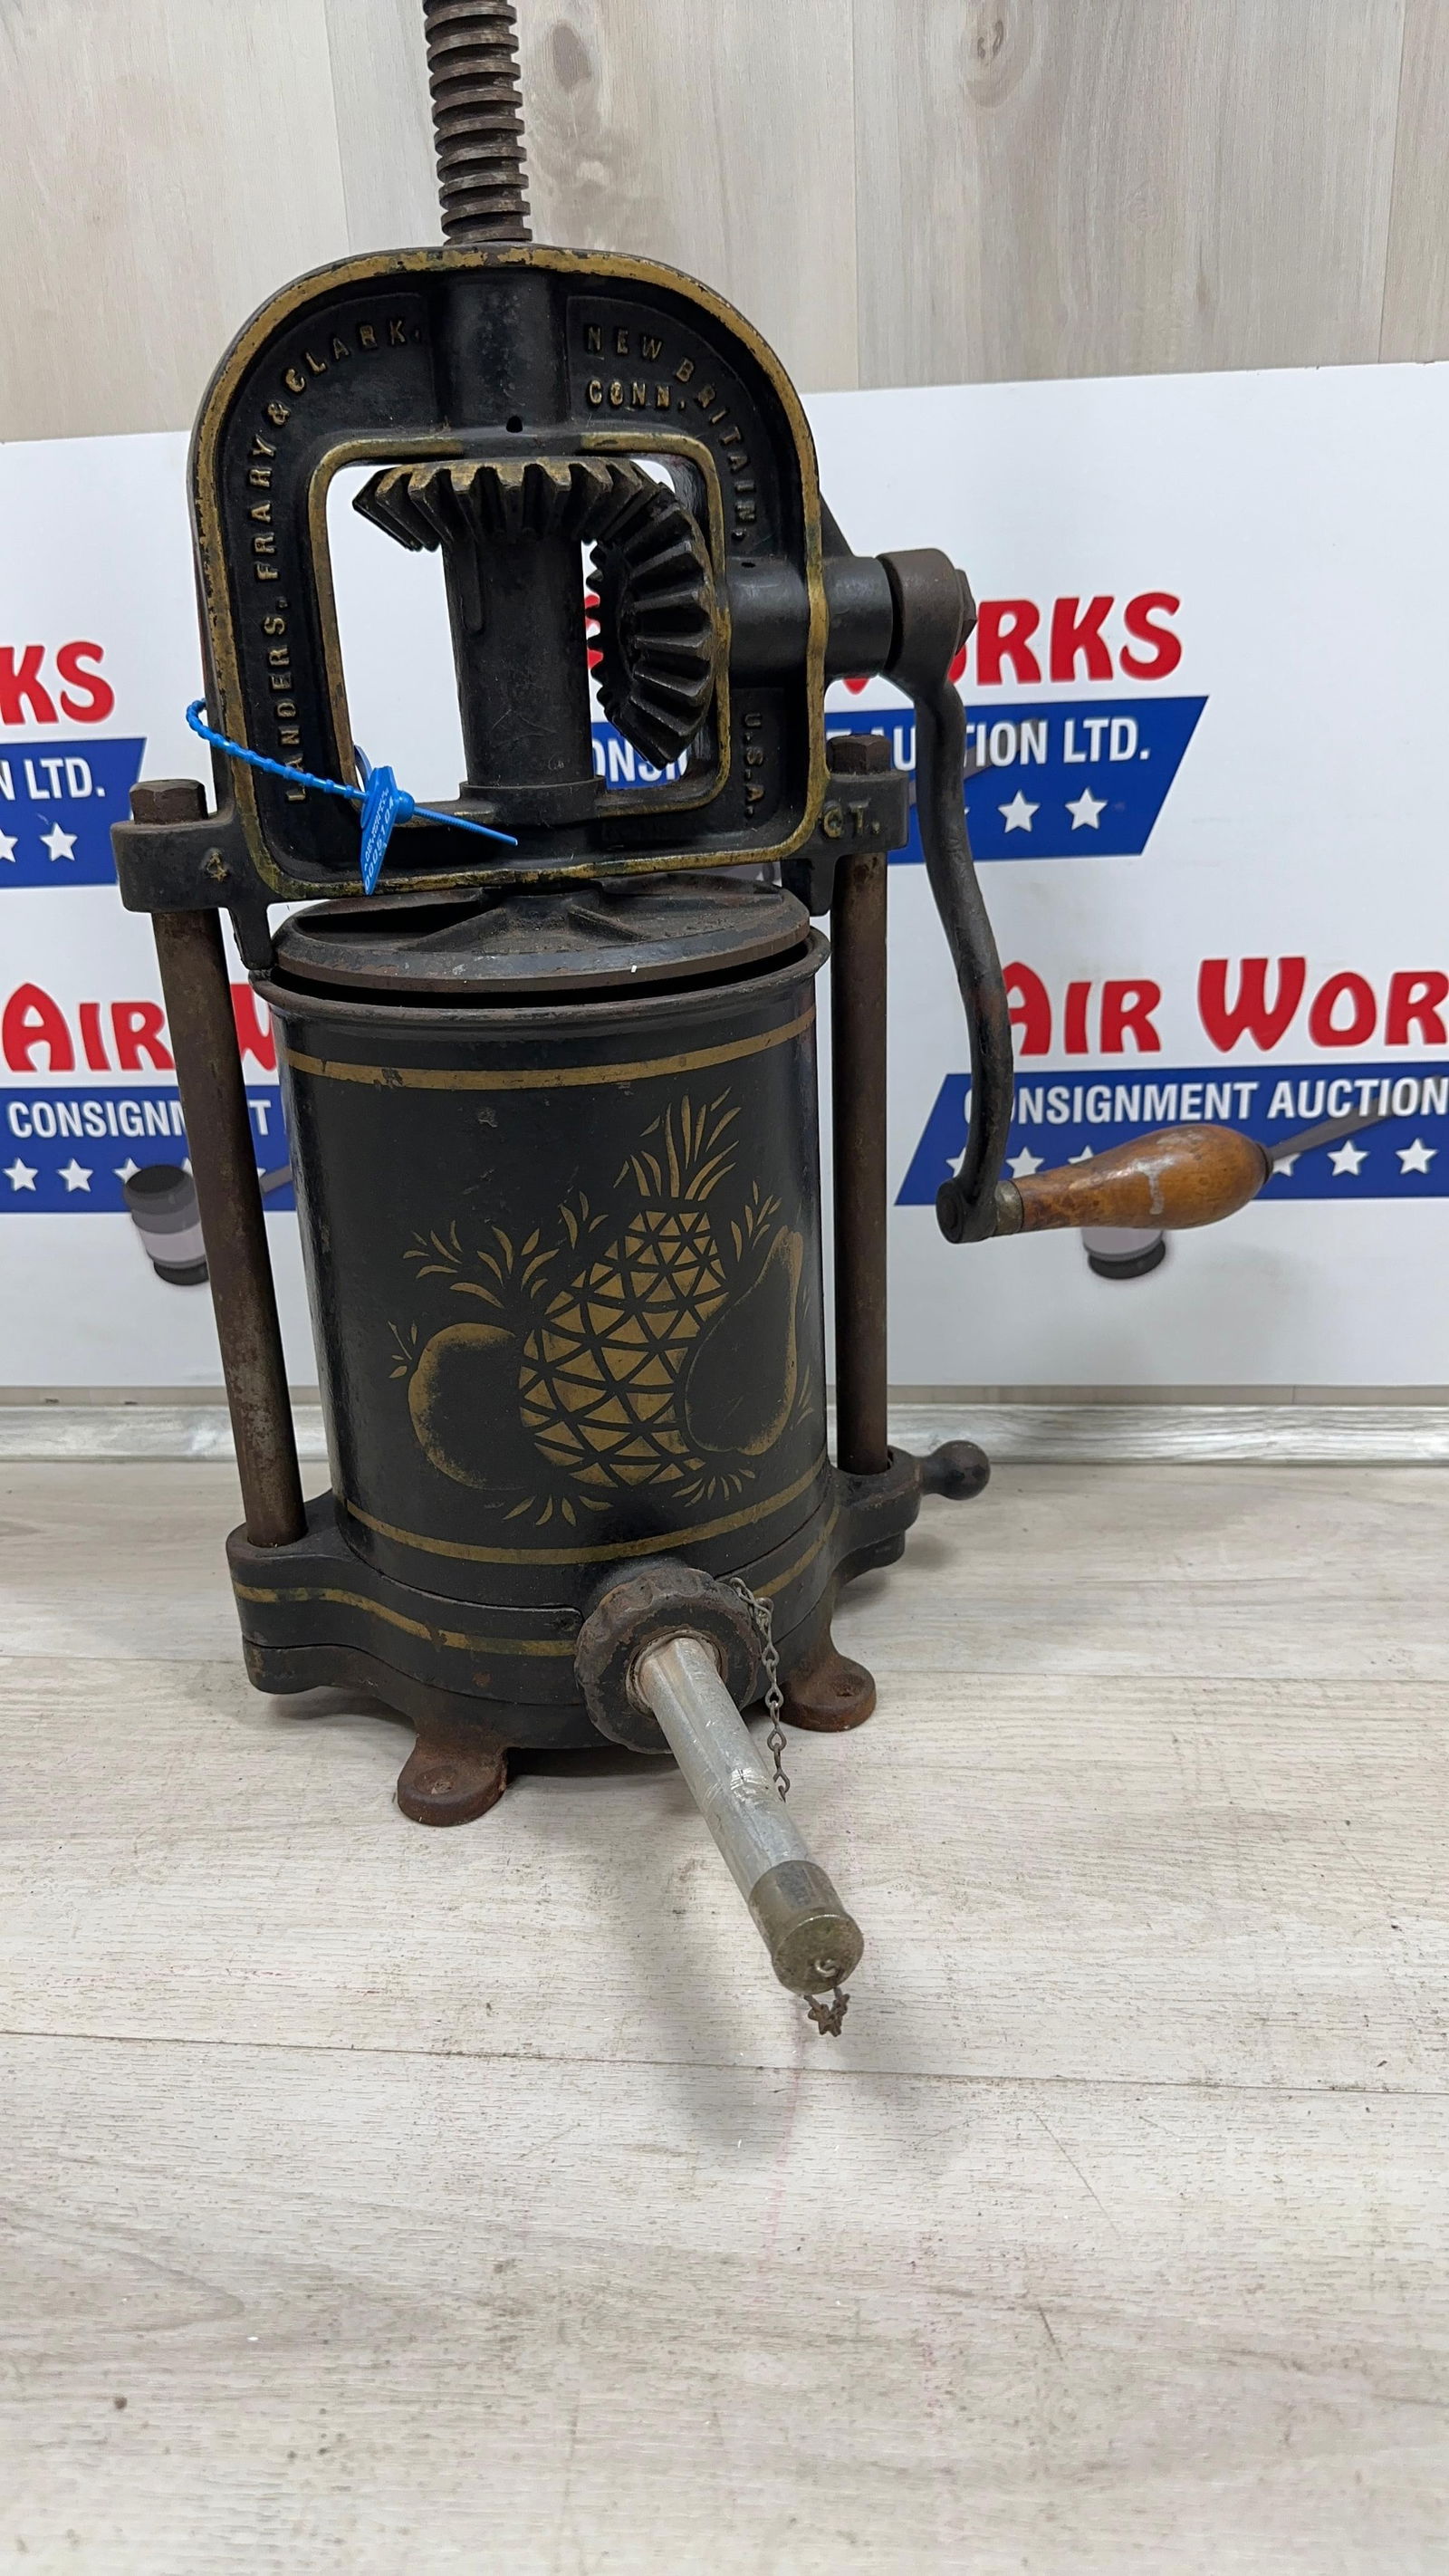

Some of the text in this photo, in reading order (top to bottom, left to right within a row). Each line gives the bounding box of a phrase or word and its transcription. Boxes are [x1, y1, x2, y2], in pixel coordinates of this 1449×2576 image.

[588, 325, 662, 360] NEW
[249, 435, 279, 581] FRARY
[267, 401, 292, 427] &
[843, 592, 1182, 695] RKS
[1063, 716, 1150, 764] LTD.
[24, 757, 106, 800] LTD.
[2, 982, 176, 1072] AIR
[1000, 960, 1162, 1056] AIR
[9, 1100, 272, 1139] CONSIGNT
[964, 1076, 1449, 1125] NSIGNMENT AUCTION
